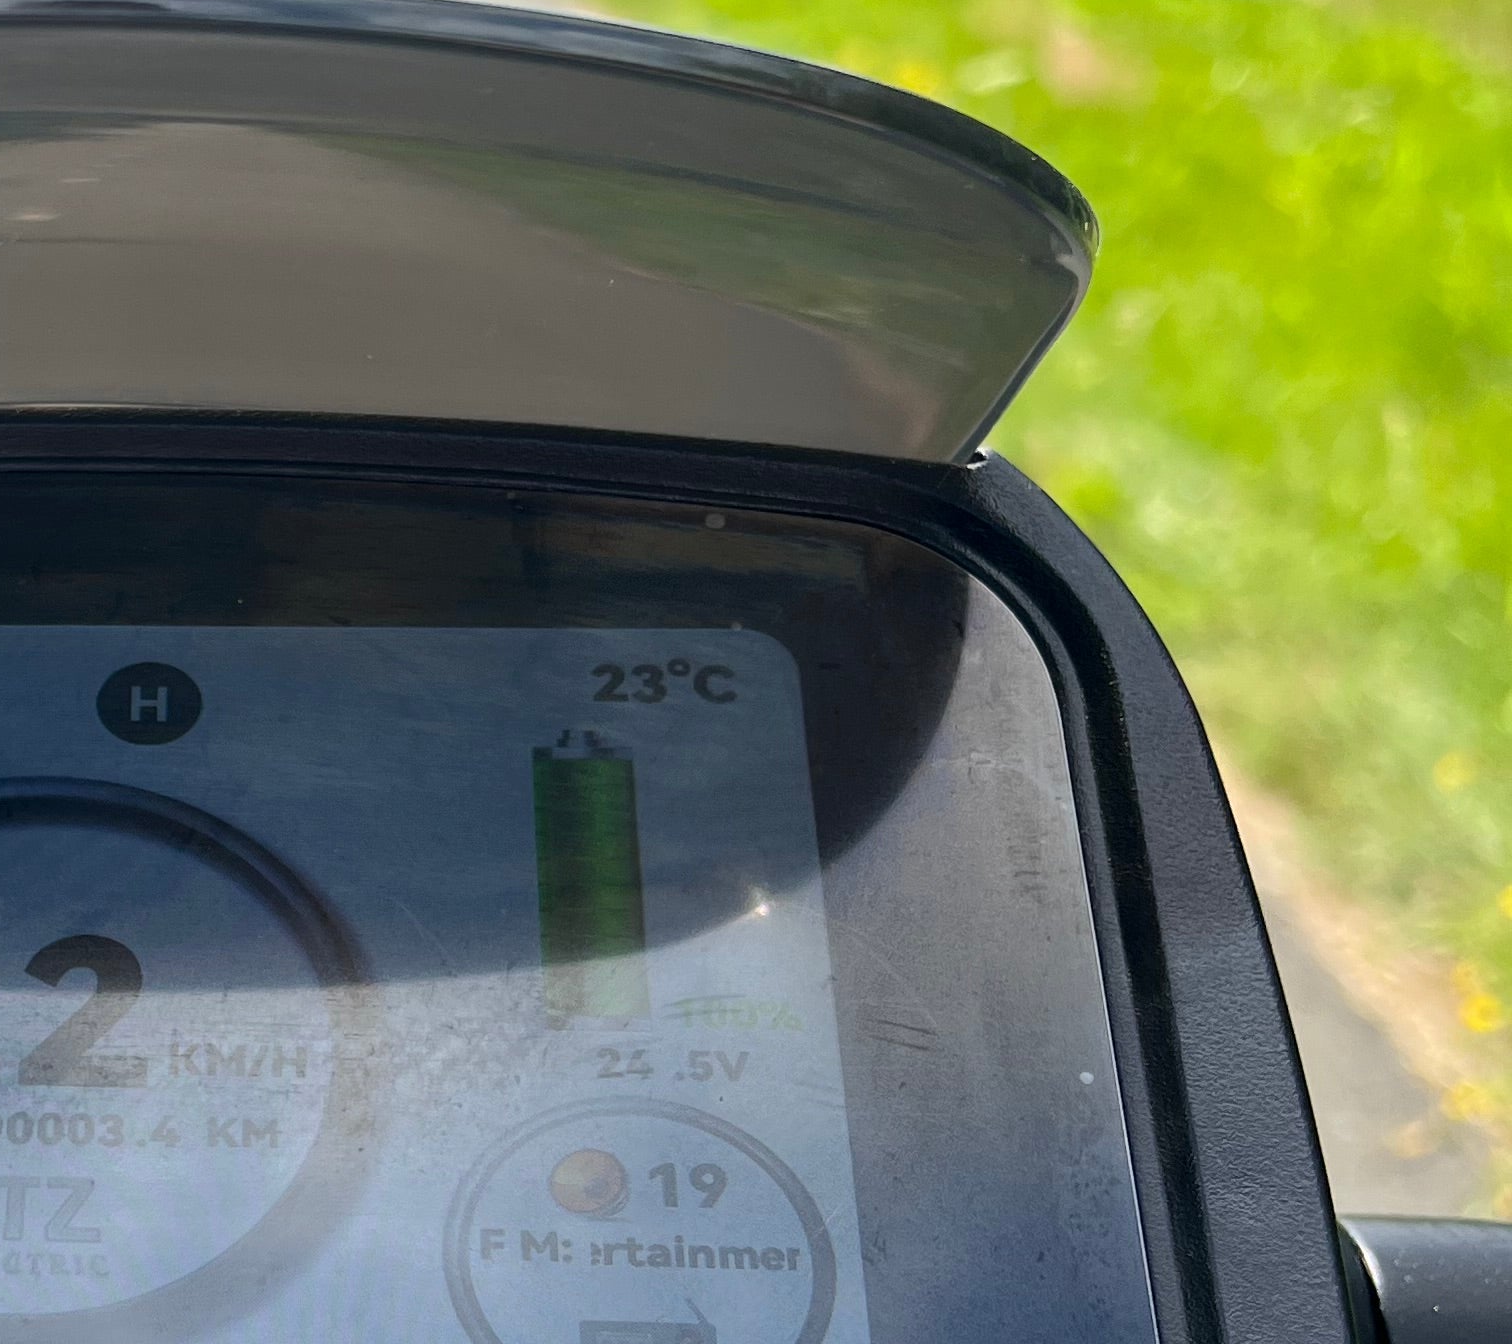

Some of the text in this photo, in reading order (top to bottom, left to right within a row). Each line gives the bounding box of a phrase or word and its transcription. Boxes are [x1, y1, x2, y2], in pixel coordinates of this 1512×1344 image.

[592, 658, 738, 704] 23°C
[129, 685, 169, 723] H
[166, 1039, 310, 1080] KM/H
[206, 1114, 284, 1150] KM
[647, 1162, 729, 1210] 19
